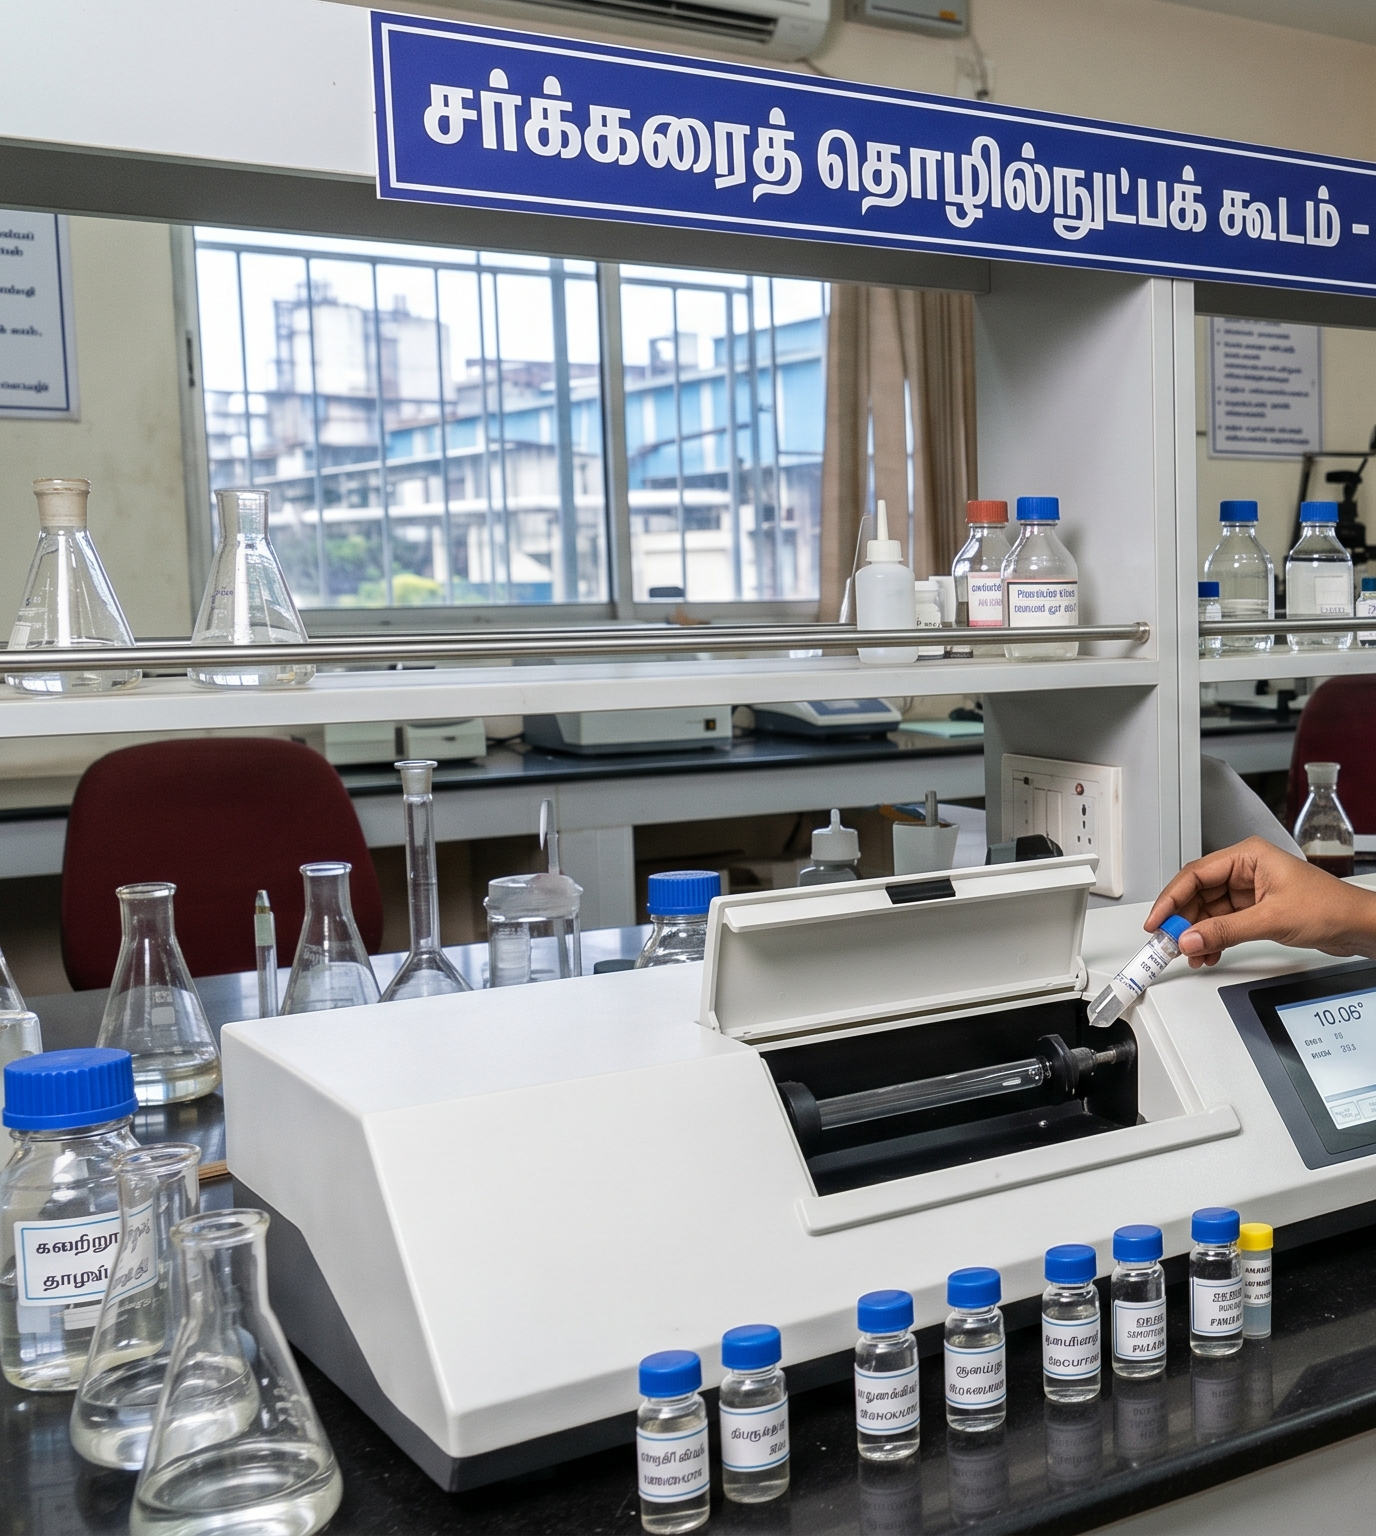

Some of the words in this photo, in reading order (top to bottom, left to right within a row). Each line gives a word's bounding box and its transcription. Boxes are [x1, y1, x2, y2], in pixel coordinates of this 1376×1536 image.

[423, 68, 803, 203] சர்க்கரைத்
[817, 128, 1207, 240] தொழில்நுட்பக்
[1219, 185, 1341, 247] கூடம்
[1313, 1001, 1364, 1027] 10.06°
